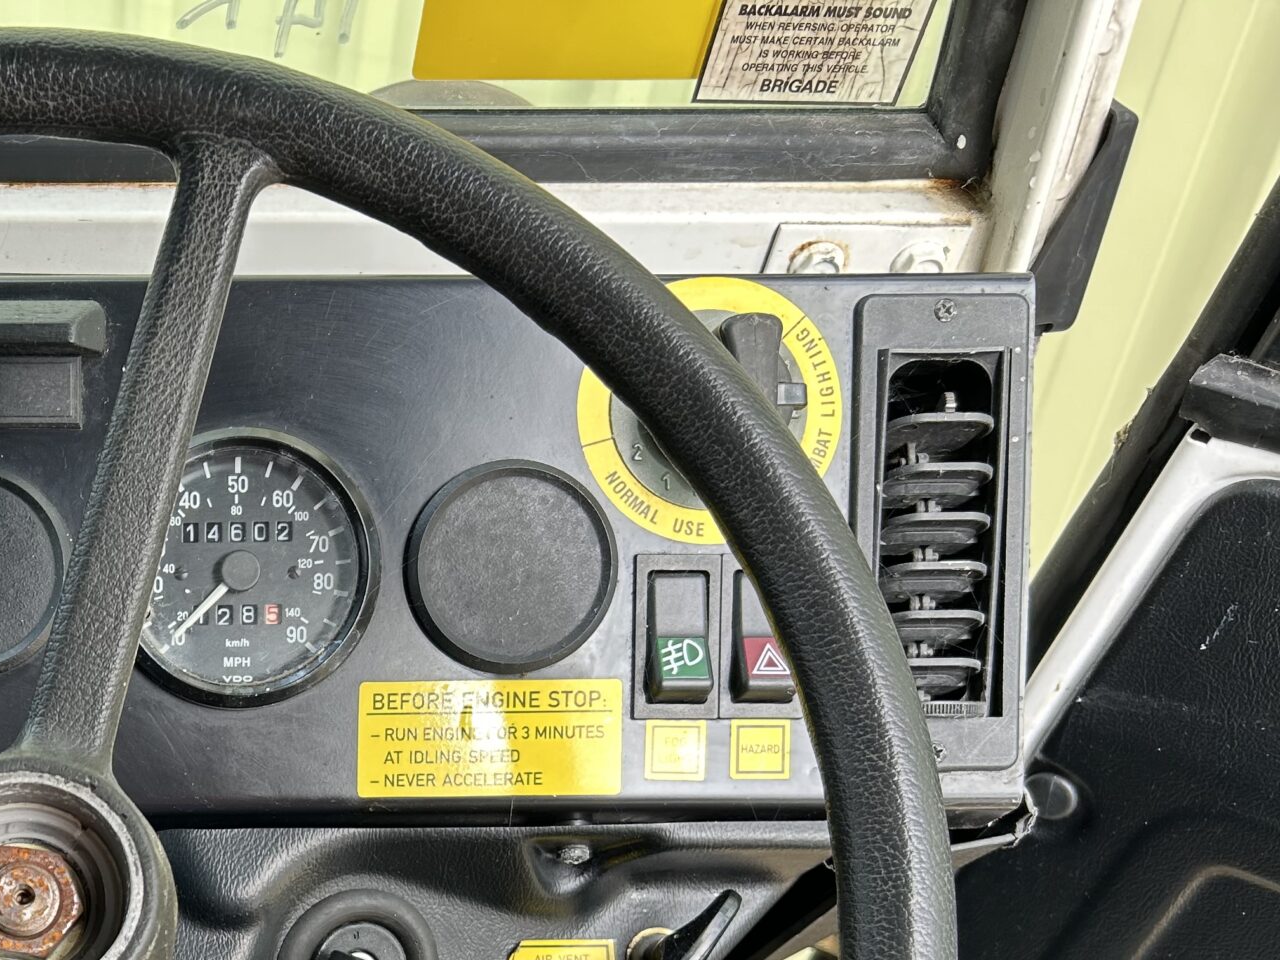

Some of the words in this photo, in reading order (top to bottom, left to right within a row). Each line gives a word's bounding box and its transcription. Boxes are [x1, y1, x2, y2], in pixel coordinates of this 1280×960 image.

[738, 4, 820, 17] BACKALARM
[823, 6, 862, 18] MUST
[863, 7, 912, 19] SOUND
[745, 21, 775, 31] WHEN
[840, 23, 896, 33] OPERATOR
[730, 35, 758, 44] MUST
[760, 36, 790, 45] MAKE
[792, 36, 834, 46] CERTAIN
[837, 37, 900, 47] BACKALARM
[758, 50, 768, 58] IS
[771, 50, 819, 59] WORKING
[821, 51, 862, 60] BEFORE
[741, 63, 798, 72] OPERATING
[802, 64, 823, 73] THIS
[759, 79, 839, 94] BRIGADE
[796, 327, 835, 417] LIGHTING
[227, 476, 249, 494] 50
[179, 491, 200, 509] 40
[272, 490, 294, 508] 60
[604, 469, 658, 525] NORMAL
[673, 517, 705, 537] USE
[230, 506, 243, 516] 80
[294, 511, 309, 522] 100
[309, 535, 329, 553] 70
[162, 563, 175, 574] 40
[297, 559, 313, 569] 120
[153, 576, 164, 593] 0
[313, 573, 334, 590] 80
[285, 608, 301, 618] 140
[286, 626, 307, 643] 90
[225, 638, 250, 648] km/h
[223, 657, 251, 668] MPH
[222, 675, 253, 683] VDO
[372, 692, 453, 711] BEFORE
[461, 690, 541, 709] ENGINE
[384, 727, 418, 742] RUN
[521, 725, 530, 739] 3
[535, 725, 605, 740] MINUTES
[741, 743, 780, 754] HAZARD
[384, 750, 403, 765] AT
[410, 750, 462, 764] IDLING
[468, 749, 521, 764] SPEED
[384, 773, 436, 787] NEVER
[442, 772, 543, 787] ACCELERATE
